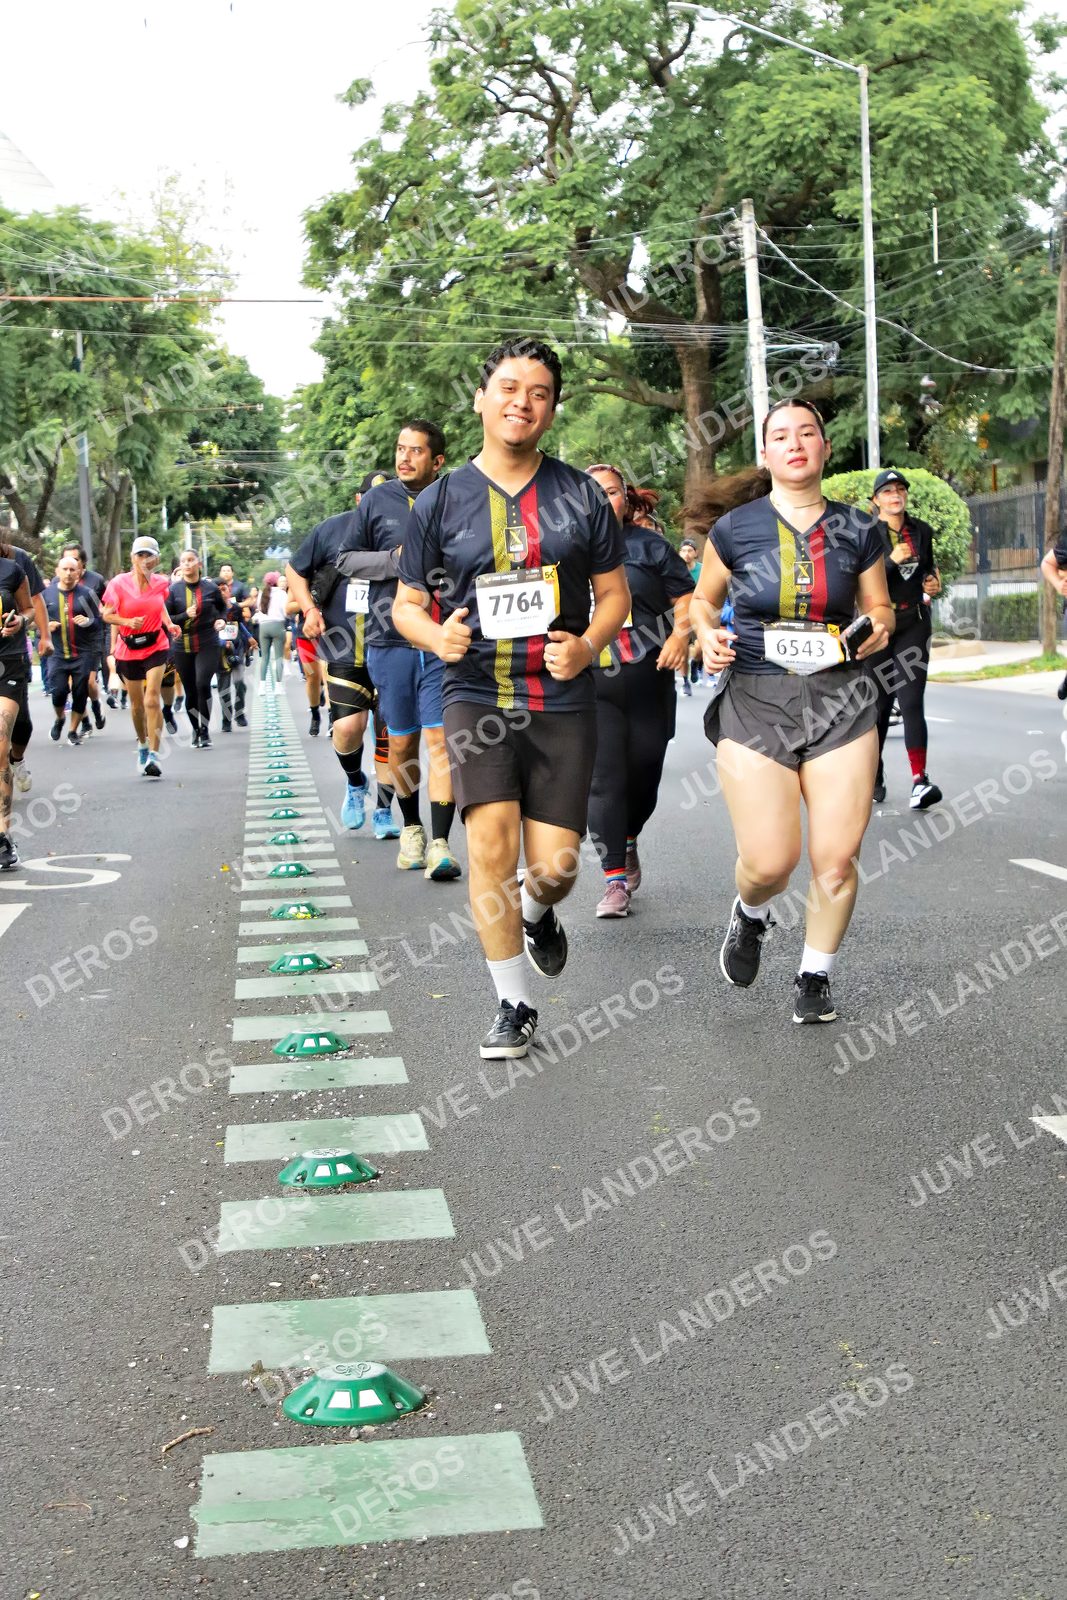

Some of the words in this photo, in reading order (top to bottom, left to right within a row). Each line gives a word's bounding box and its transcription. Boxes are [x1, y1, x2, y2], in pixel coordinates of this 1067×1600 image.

[355, 590, 368, 600] 17
[489, 590, 543, 616] 7764
[776, 638, 825, 657] 6543
